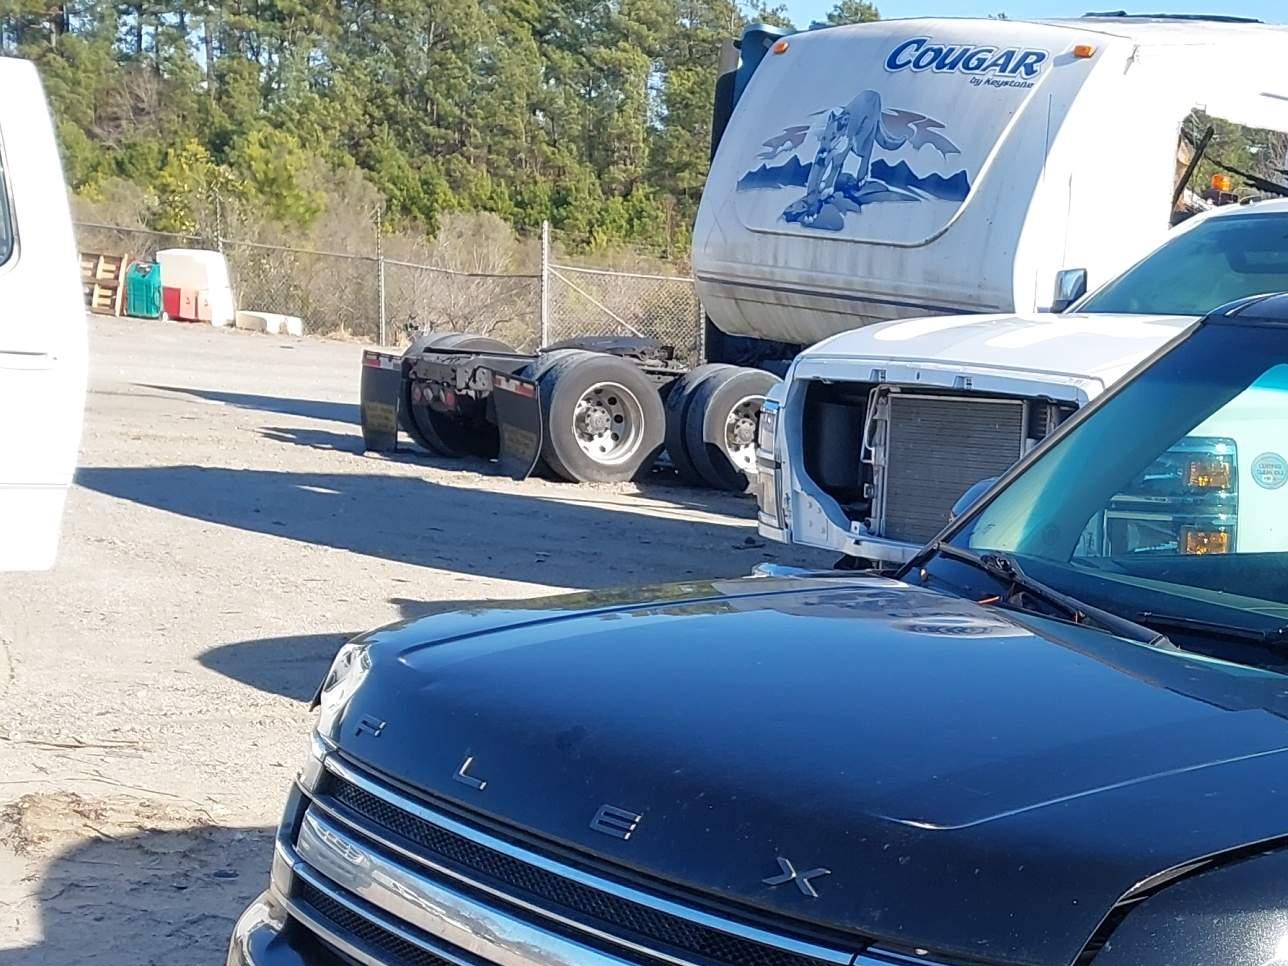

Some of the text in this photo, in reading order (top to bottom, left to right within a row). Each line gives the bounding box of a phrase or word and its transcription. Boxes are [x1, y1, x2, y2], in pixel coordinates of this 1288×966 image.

[886, 37, 1047, 77] COUGAR
[969, 76, 1035, 89] by Keystone
[355, 713, 832, 897] FLEX
